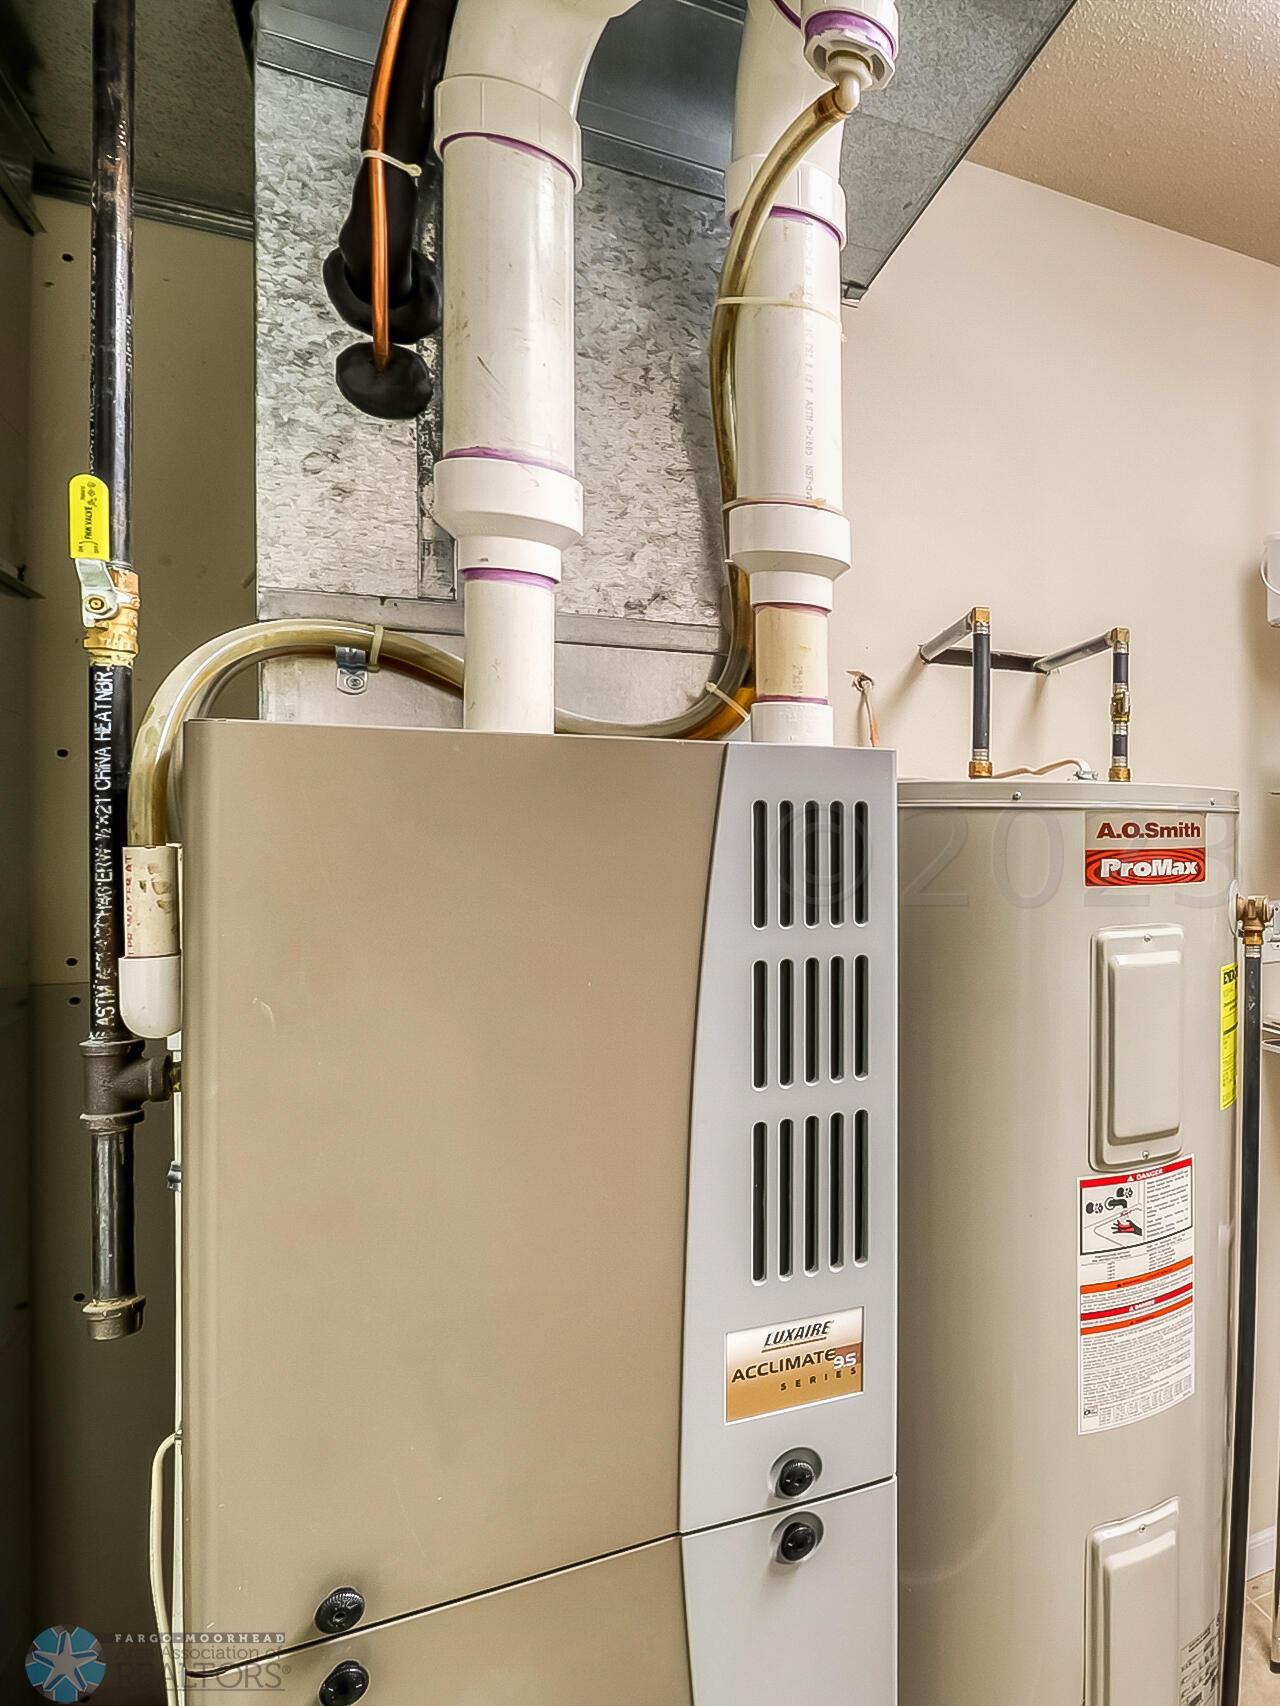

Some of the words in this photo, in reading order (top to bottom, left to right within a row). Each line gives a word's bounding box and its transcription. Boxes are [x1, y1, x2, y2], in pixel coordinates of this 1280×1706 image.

[94, 746, 112, 790] CHINA
[1096, 822, 1201, 839] A.O.Smith
[1101, 858, 1198, 878] ProMax
[764, 1320, 832, 1347] LUXAIRE
[731, 1347, 837, 1383] ACCLIMATE
[780, 1367, 857, 1391] SERIES
